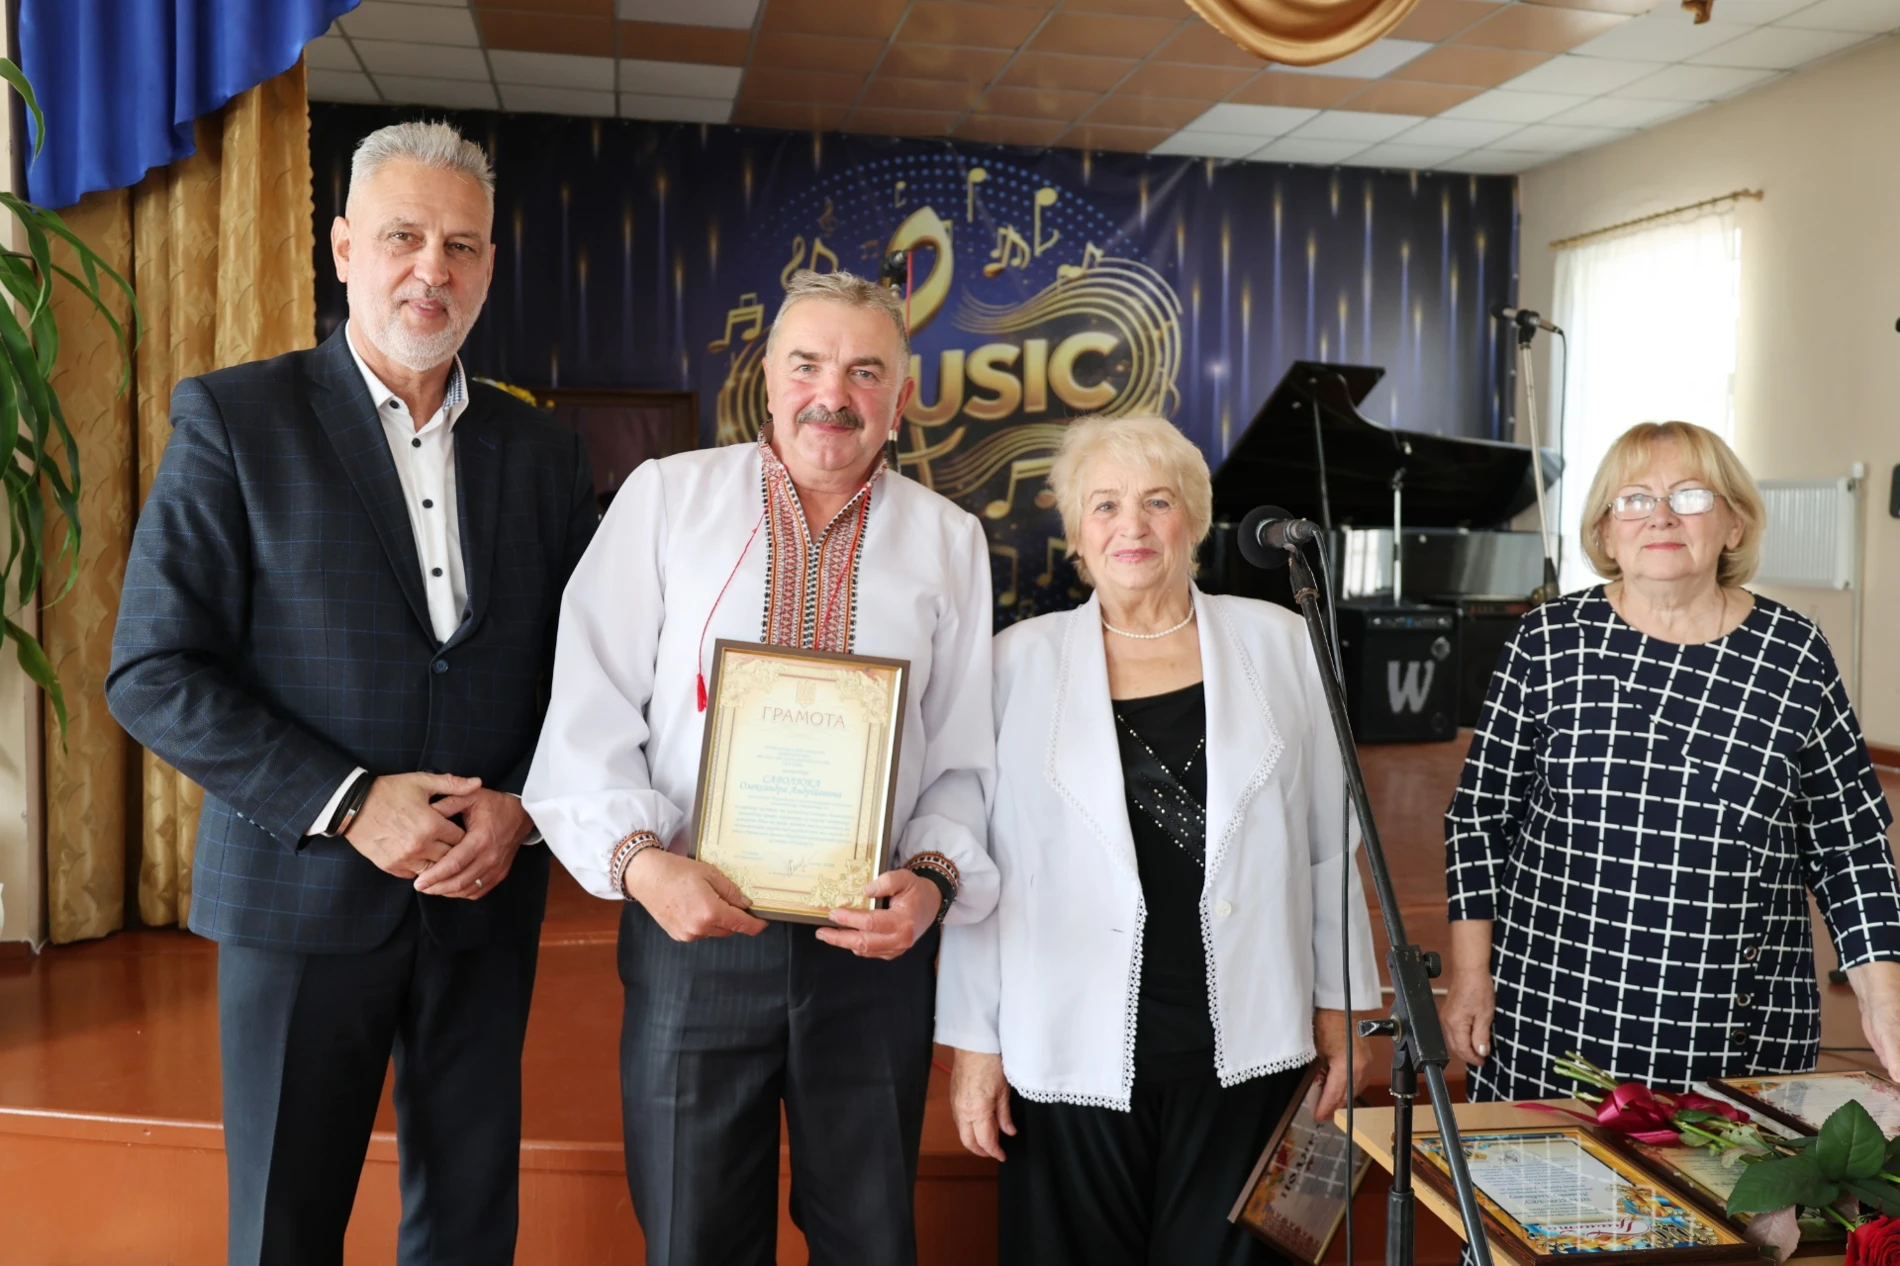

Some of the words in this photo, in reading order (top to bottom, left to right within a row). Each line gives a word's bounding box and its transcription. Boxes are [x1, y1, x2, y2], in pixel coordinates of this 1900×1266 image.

[903, 331, 1119, 427] USIC
[1387, 659, 1435, 714] W
[762, 706, 845, 728] ГРАМОТА
